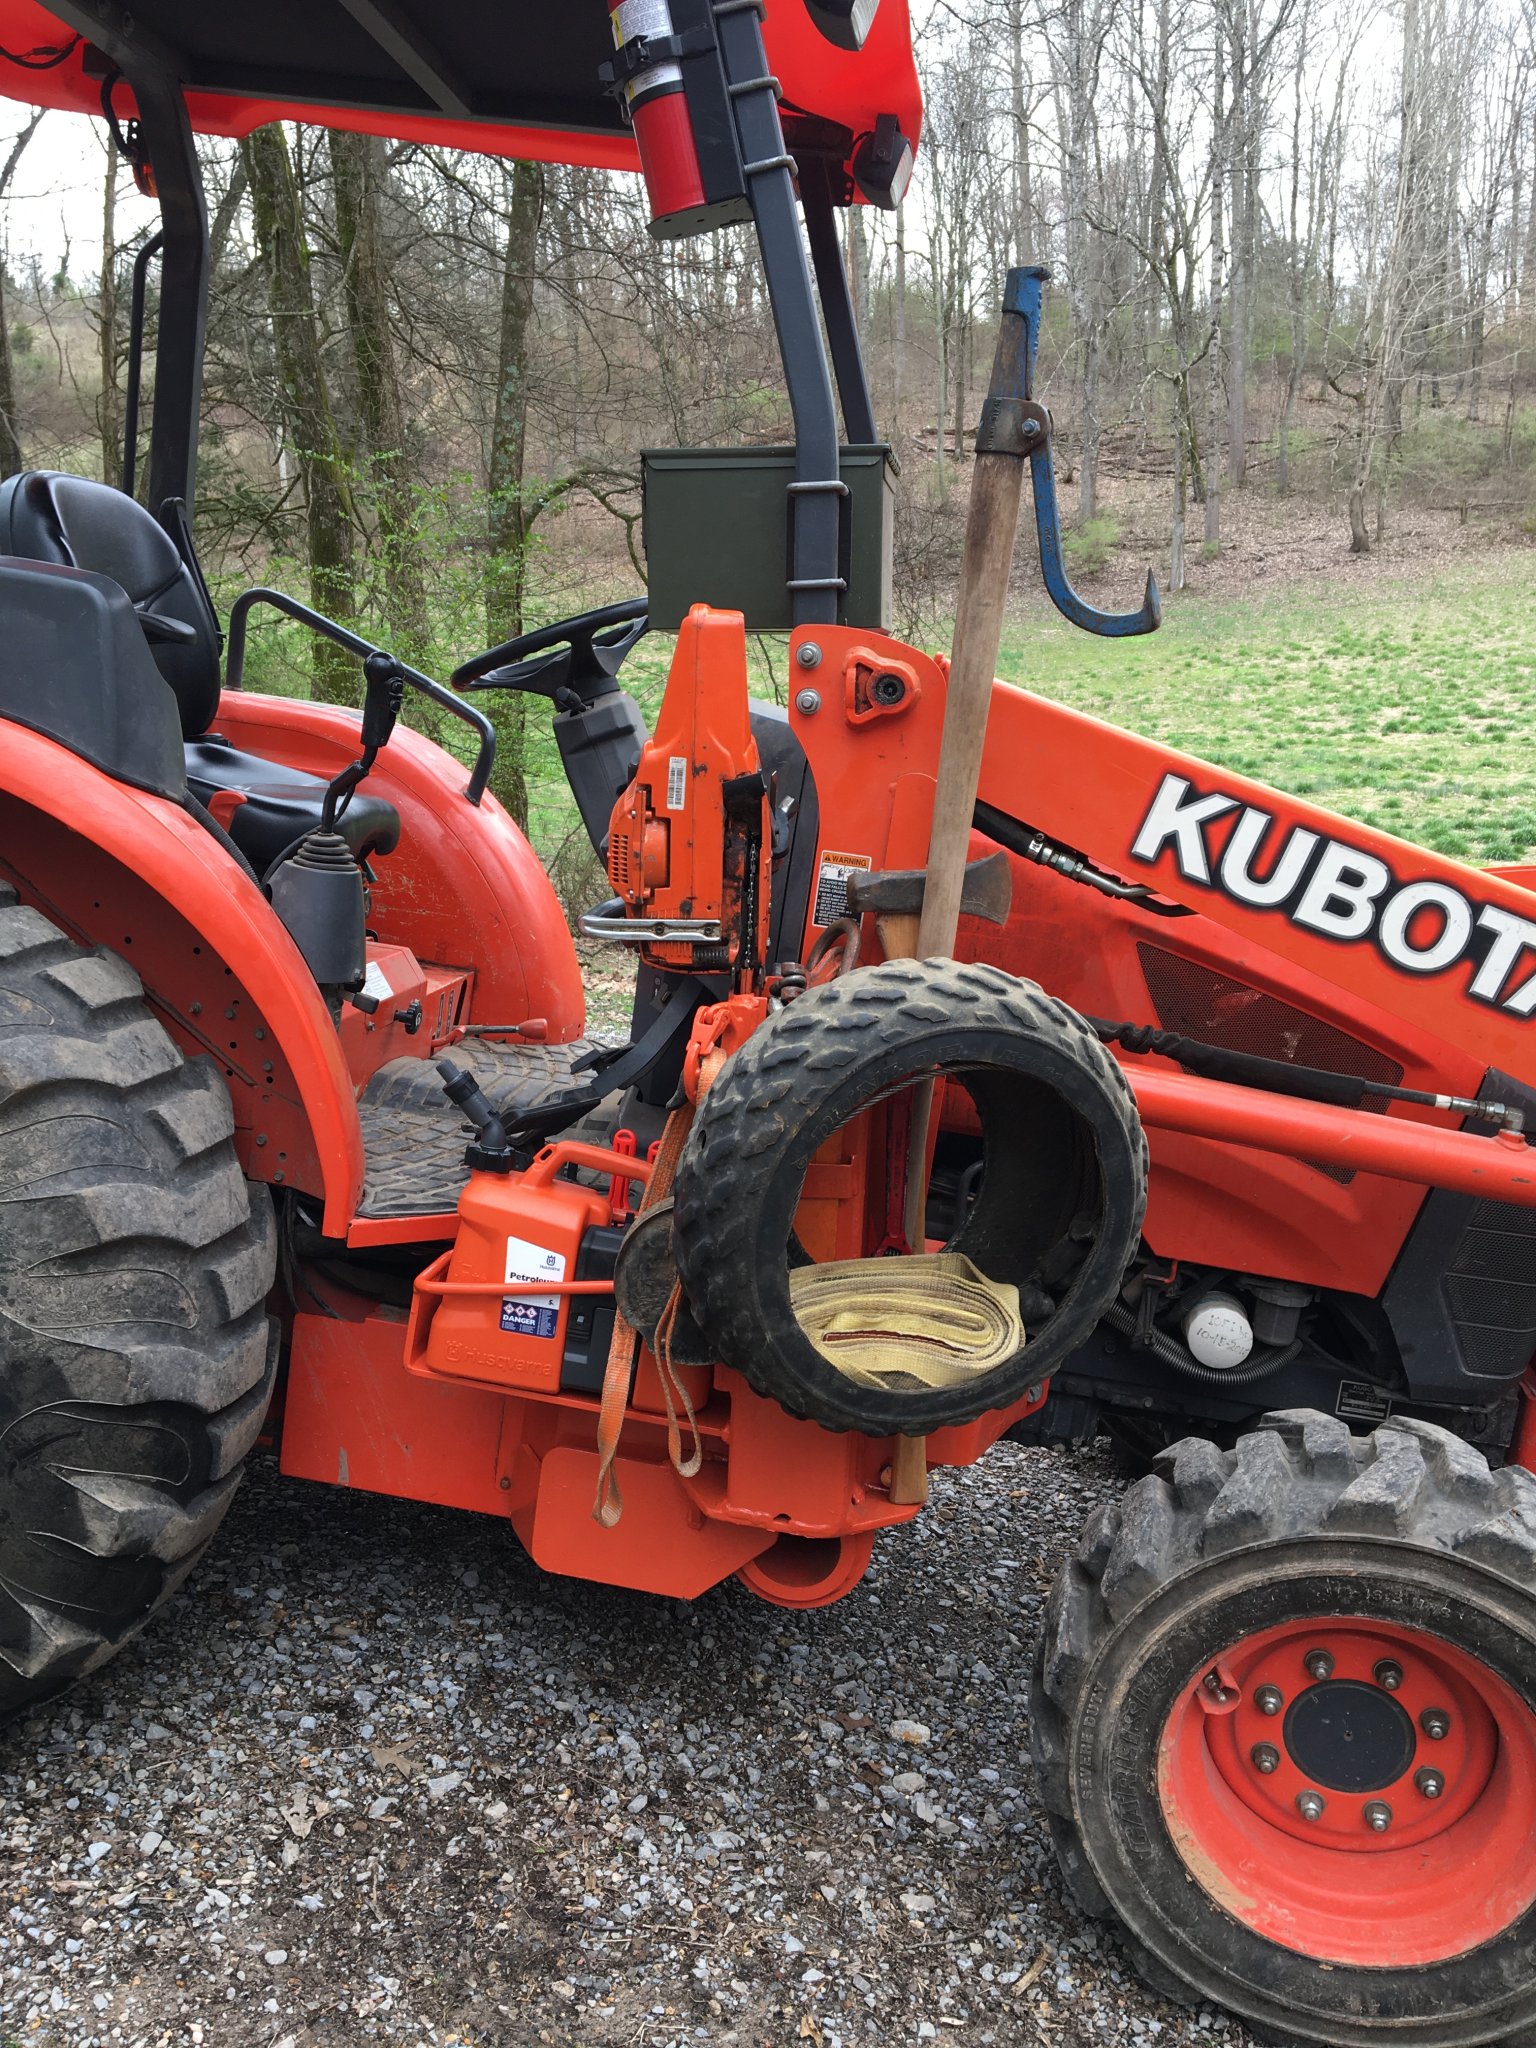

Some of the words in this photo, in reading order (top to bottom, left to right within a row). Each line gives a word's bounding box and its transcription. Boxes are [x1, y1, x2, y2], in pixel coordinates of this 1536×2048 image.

[832, 855, 867, 867] WARNING
[510, 1271, 558, 1283] Petrole
[502, 1314, 536, 1326] DANGER
[464, 1345, 553, 1377] Husqvarna
[1082, 1680, 1107, 1728] DUTY
[1079, 1732, 1094, 1801] SEVERE
